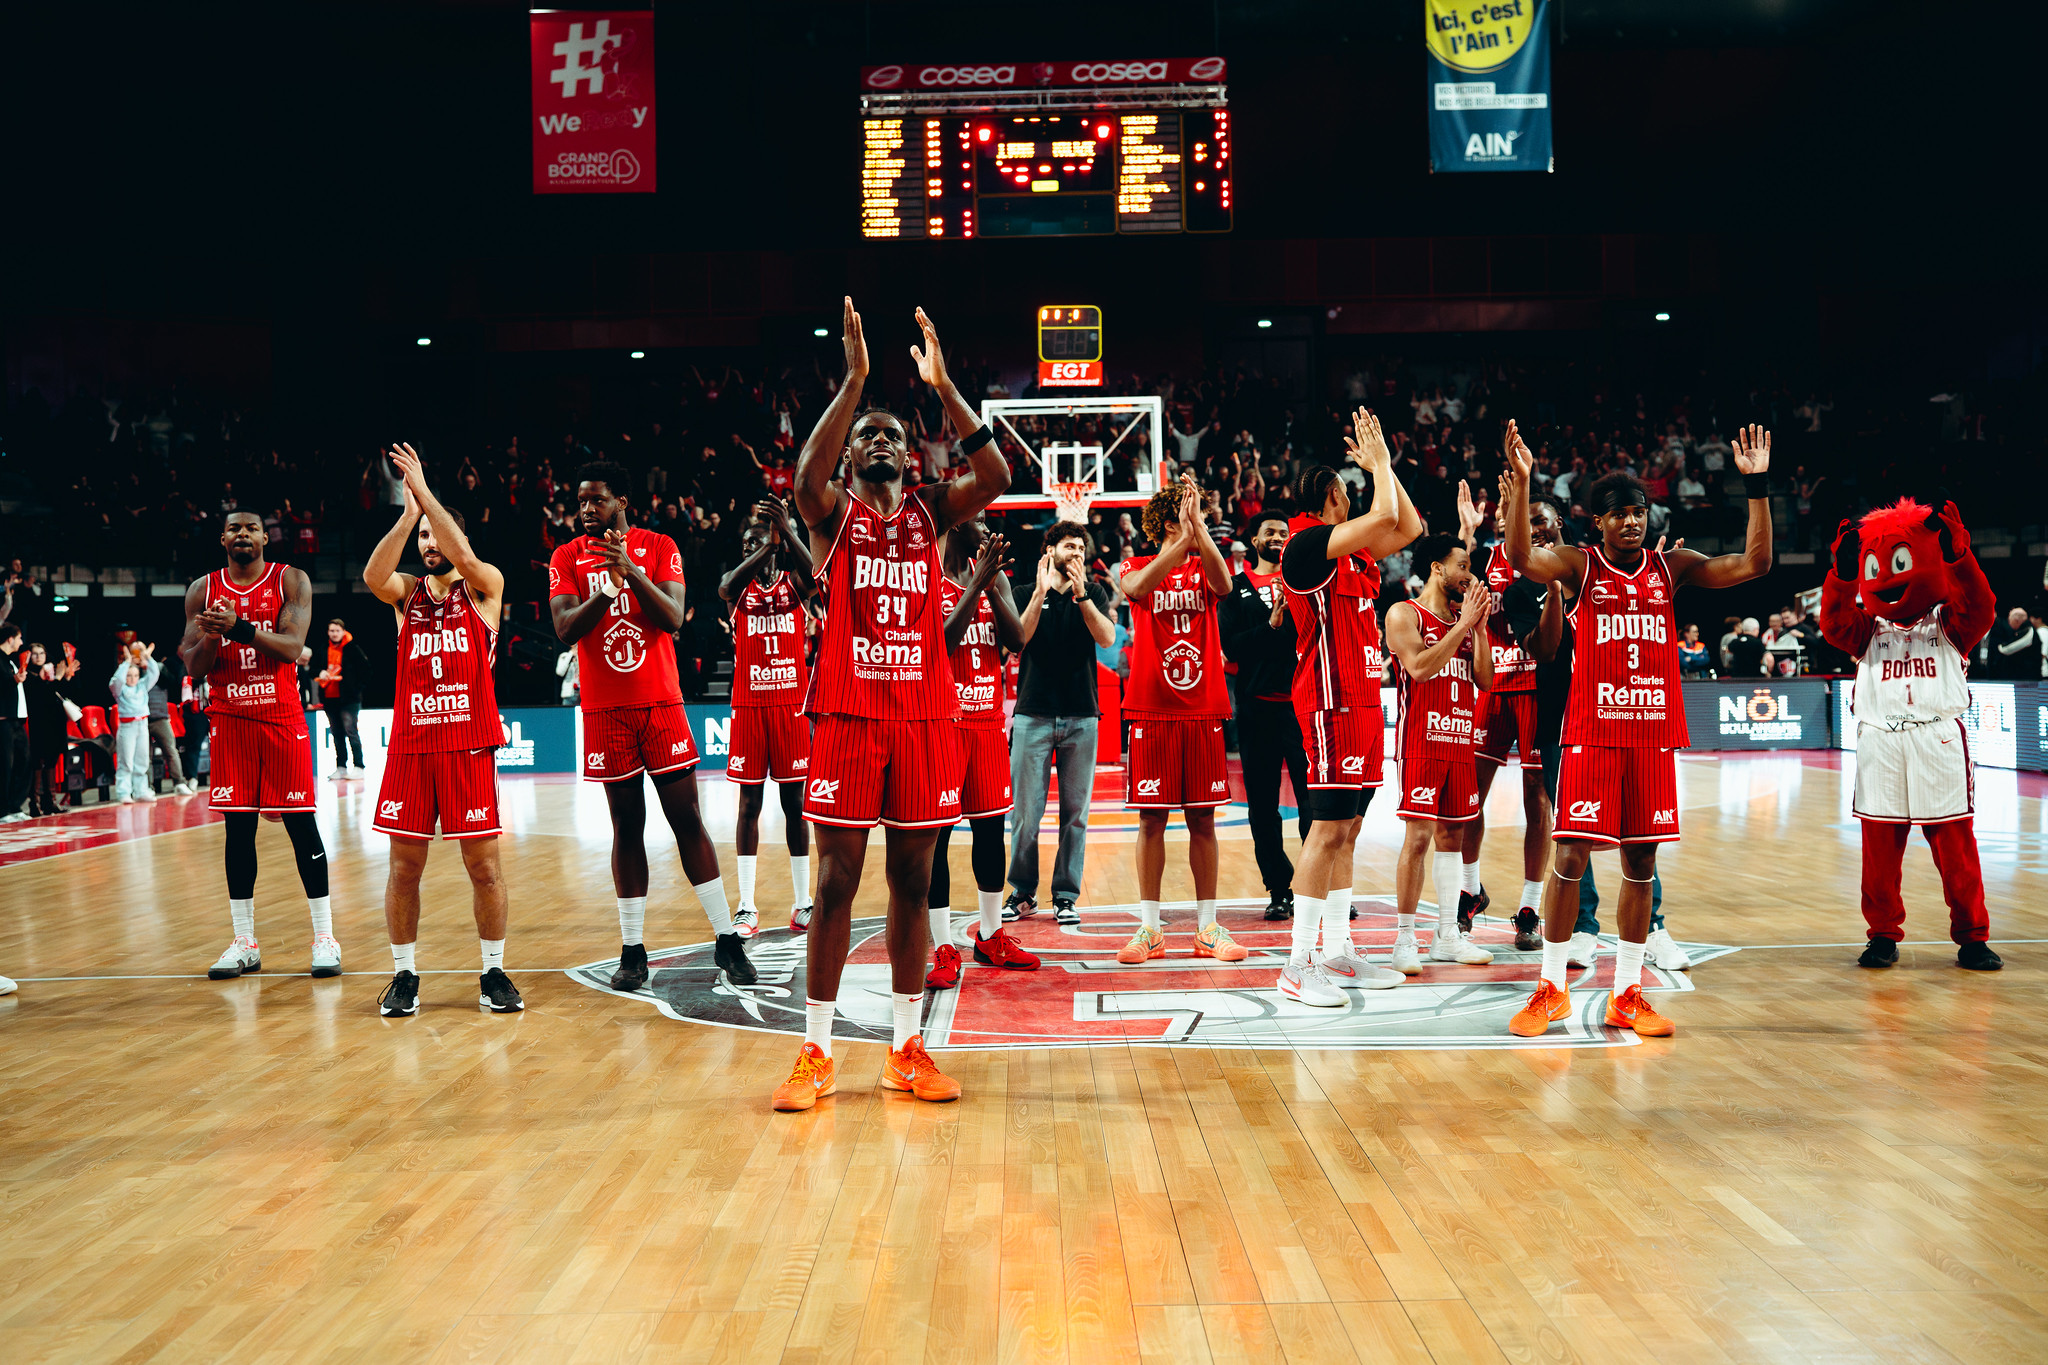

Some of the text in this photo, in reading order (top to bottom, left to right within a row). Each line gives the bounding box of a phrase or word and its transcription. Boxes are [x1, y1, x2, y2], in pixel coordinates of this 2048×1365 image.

[1433, 0, 1523, 32] Ici, c'est
[1451, 31, 1500, 54] l'Ain
[919, 66, 1016, 85] cosea
[1071, 62, 1168, 82] cosea
[1465, 131, 1517, 156] AIN
[558, 153, 609, 163] GRAND
[548, 164, 610, 177] BOURG
[1052, 363, 1090, 379] EGT
[887, 545, 898, 557] JL
[854, 555, 927, 594] BOURG
[610, 593, 630, 617] 20
[876, 595, 907, 626] 34
[1153, 589, 1206, 614] BOURG
[1628, 600, 1638, 611] JL
[747, 613, 795, 637] BOURG
[1173, 614, 1191, 634] 10
[1596, 614, 1667, 645] BOURG
[410, 627, 469, 660] BOURG
[603, 628, 645, 652] SEMCODA
[764, 636, 779, 654] 11
[885, 631, 922, 641] Charles
[239, 648, 257, 670] 12
[853, 636, 922, 664] Réma
[971, 648, 981, 669] 6
[1163, 648, 1203, 668] SEMCODA
[1627, 643, 1640, 669] 3
[431, 656, 443, 679] 8
[771, 658, 795, 666] Charles
[1881, 657, 1937, 682] BOURG
[248, 674, 275, 682] Charles
[750, 665, 797, 681] Réma
[854, 666, 890, 681] Cuisines
[900, 670, 922, 681] bains
[1630, 675, 1664, 685] Charles
[227, 682, 276, 698] Réma
[436, 682, 469, 693] Charles
[750, 683, 775, 691] Cuisines
[954, 683, 995, 700] Réma
[1451, 681, 1459, 702] 0
[1597, 683, 1666, 706] Réma
[1906, 684, 1914, 706] 1
[259, 697, 277, 705] bains
[411, 693, 470, 713] Réma
[1719, 688, 1801, 722] NÖL
[411, 716, 442, 726] Cuisines
[449, 713, 471, 723] bains
[1452, 707, 1473, 717] Charles
[1597, 709, 1634, 720] Cuisines
[1644, 709, 1666, 720] bains
[1427, 711, 1473, 734] Réma
[1426, 732, 1453, 743] Cuisines
[1653, 809, 1673, 822] AIN
